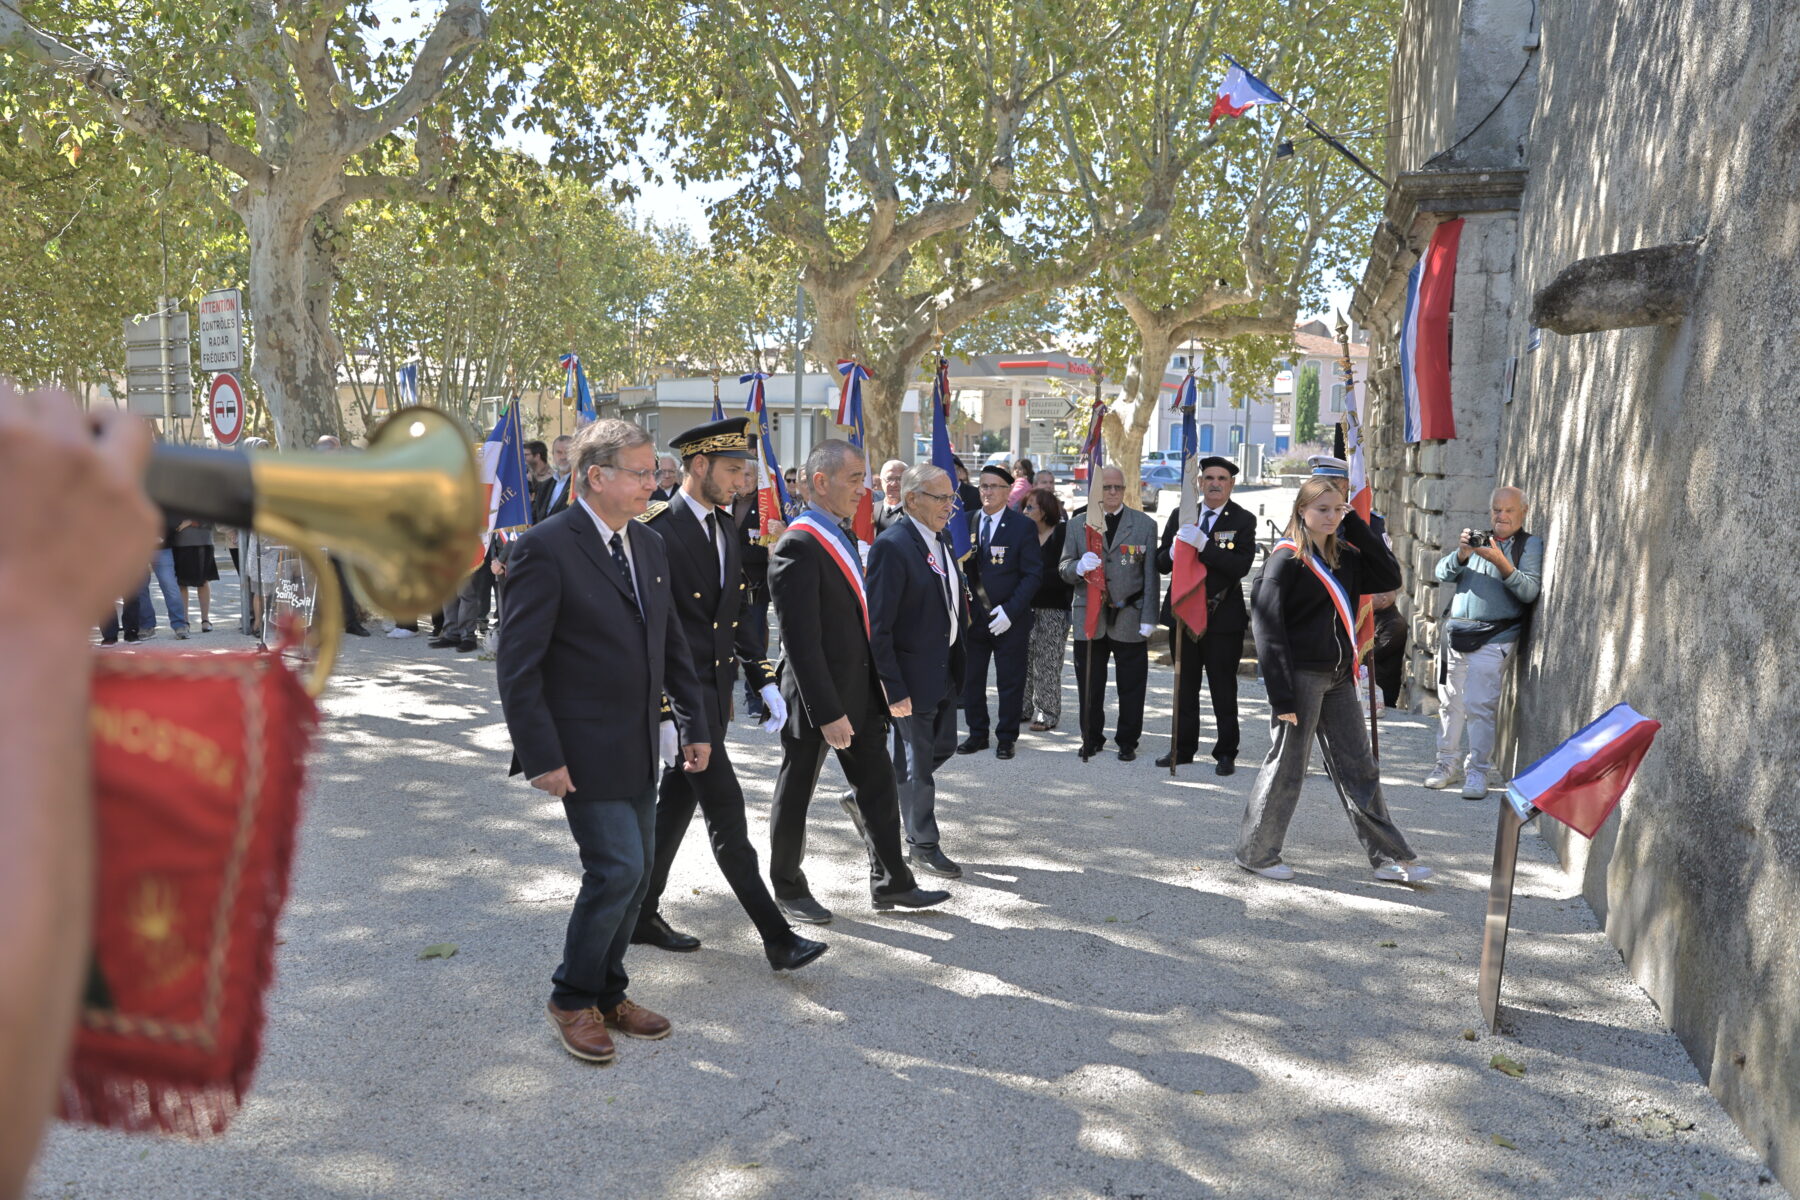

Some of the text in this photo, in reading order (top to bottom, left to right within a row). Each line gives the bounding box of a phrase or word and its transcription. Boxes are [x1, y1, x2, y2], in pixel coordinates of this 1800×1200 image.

[201, 299, 236, 314] ATTENTION
[202, 317, 235, 332] CONTRÔLES
[208, 336, 229, 347] RADAR
[203, 351, 236, 363] FRÉQUENTS
